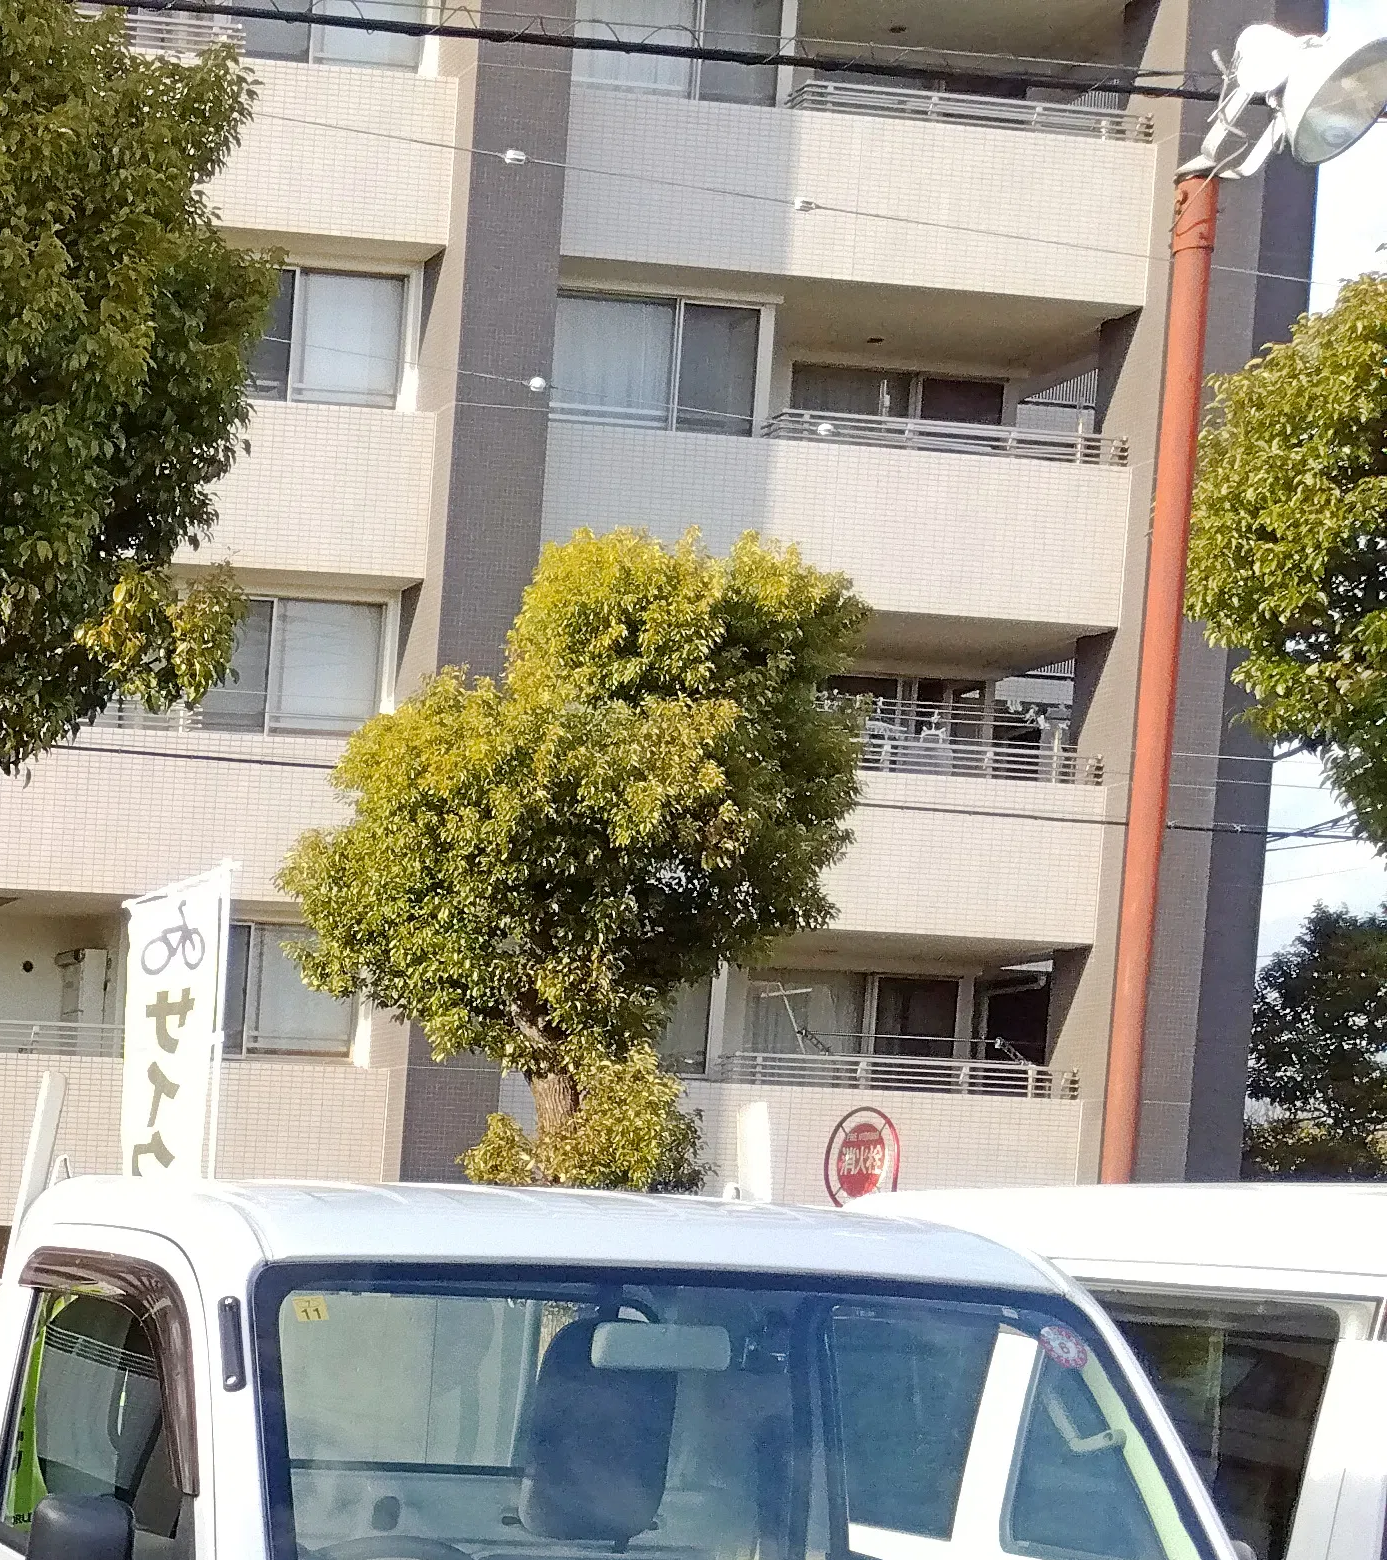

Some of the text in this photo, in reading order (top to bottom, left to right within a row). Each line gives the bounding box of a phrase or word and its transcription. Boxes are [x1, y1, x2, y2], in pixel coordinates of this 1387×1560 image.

[838, 1144, 883, 1176] 消火栓
[301, 1307, 322, 1320] 11
